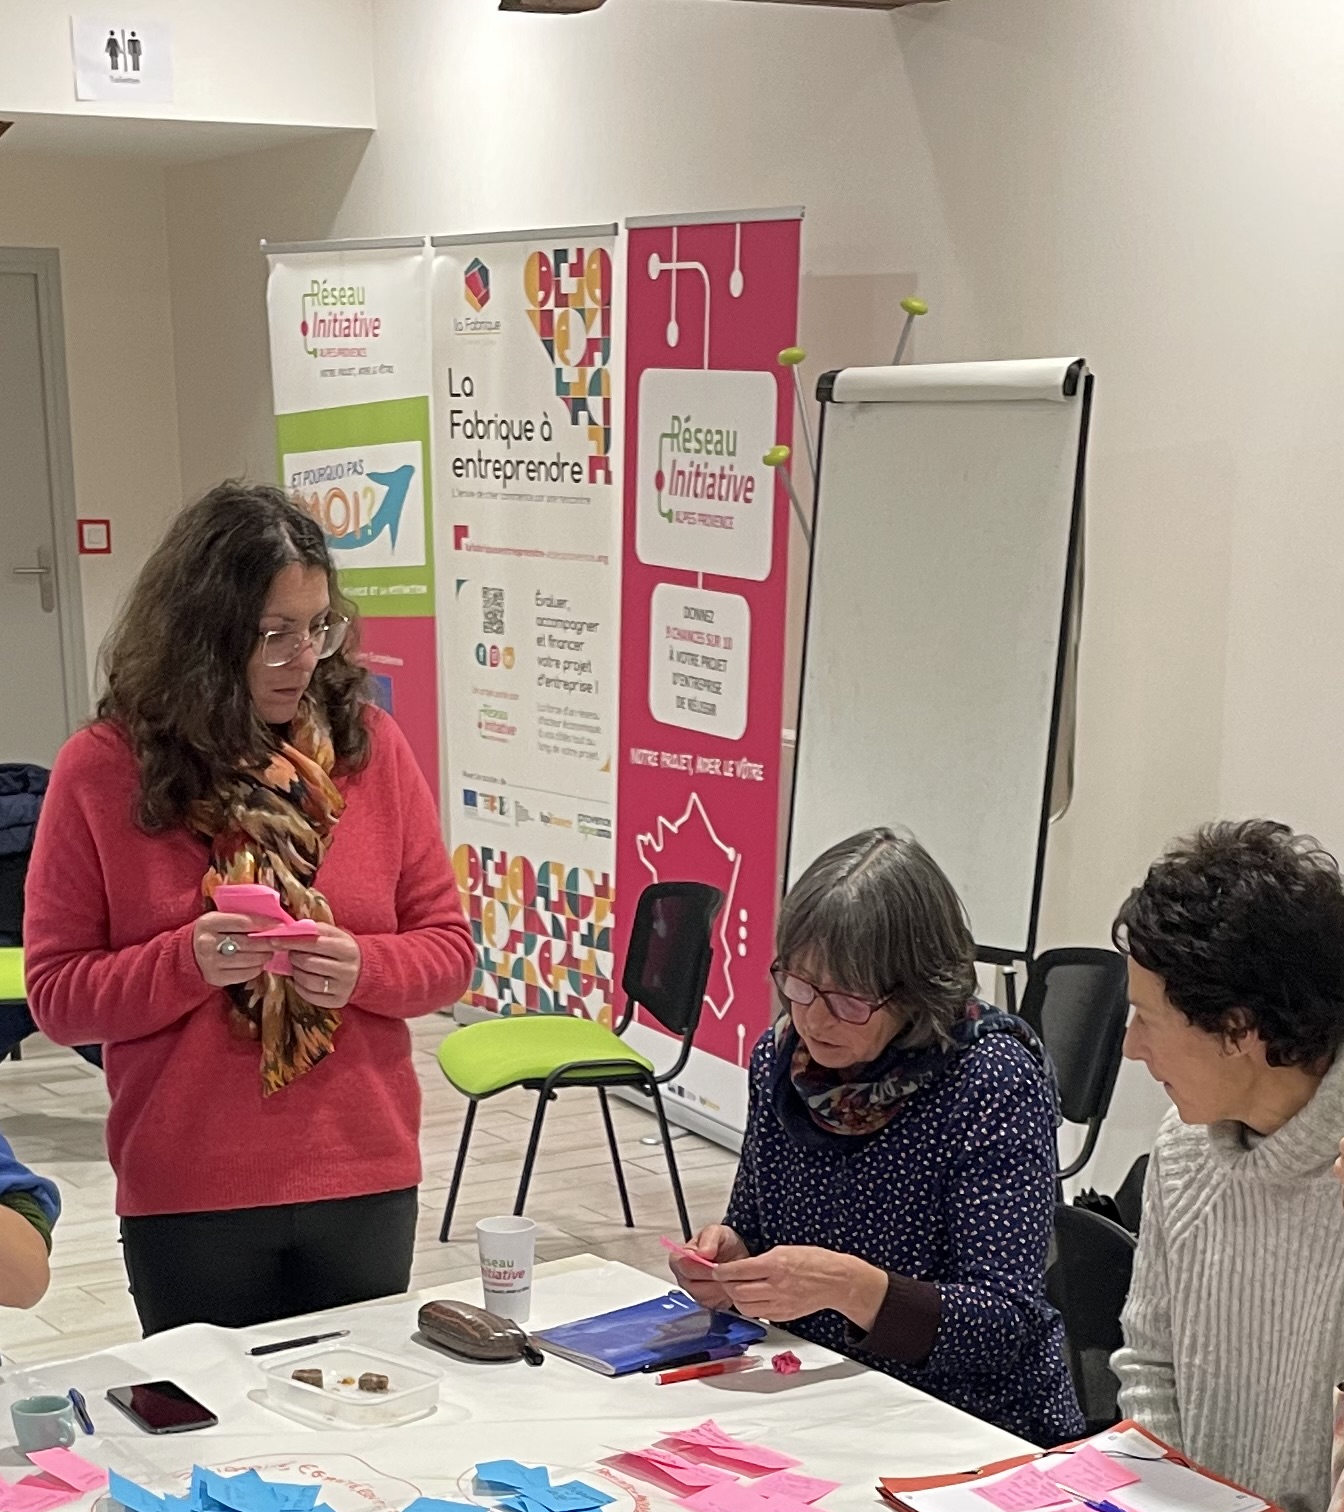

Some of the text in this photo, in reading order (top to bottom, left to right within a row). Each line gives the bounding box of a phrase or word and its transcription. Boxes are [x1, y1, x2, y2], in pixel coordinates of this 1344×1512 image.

[311, 279, 365, 306] Réseau
[312, 311, 382, 338] Initiative
[448, 367, 474, 398] La
[450, 409, 553, 450] Fabrique à
[670, 414, 737, 457] Réseau
[452, 448, 583, 489] entreprendre
[669, 459, 755, 504] Initiative
[683, 605, 714, 624] DONNEZ
[537, 656, 592, 675] votre projet
[701, 655, 728, 673] PROJET
[481, 1254, 514, 1268] éseau
